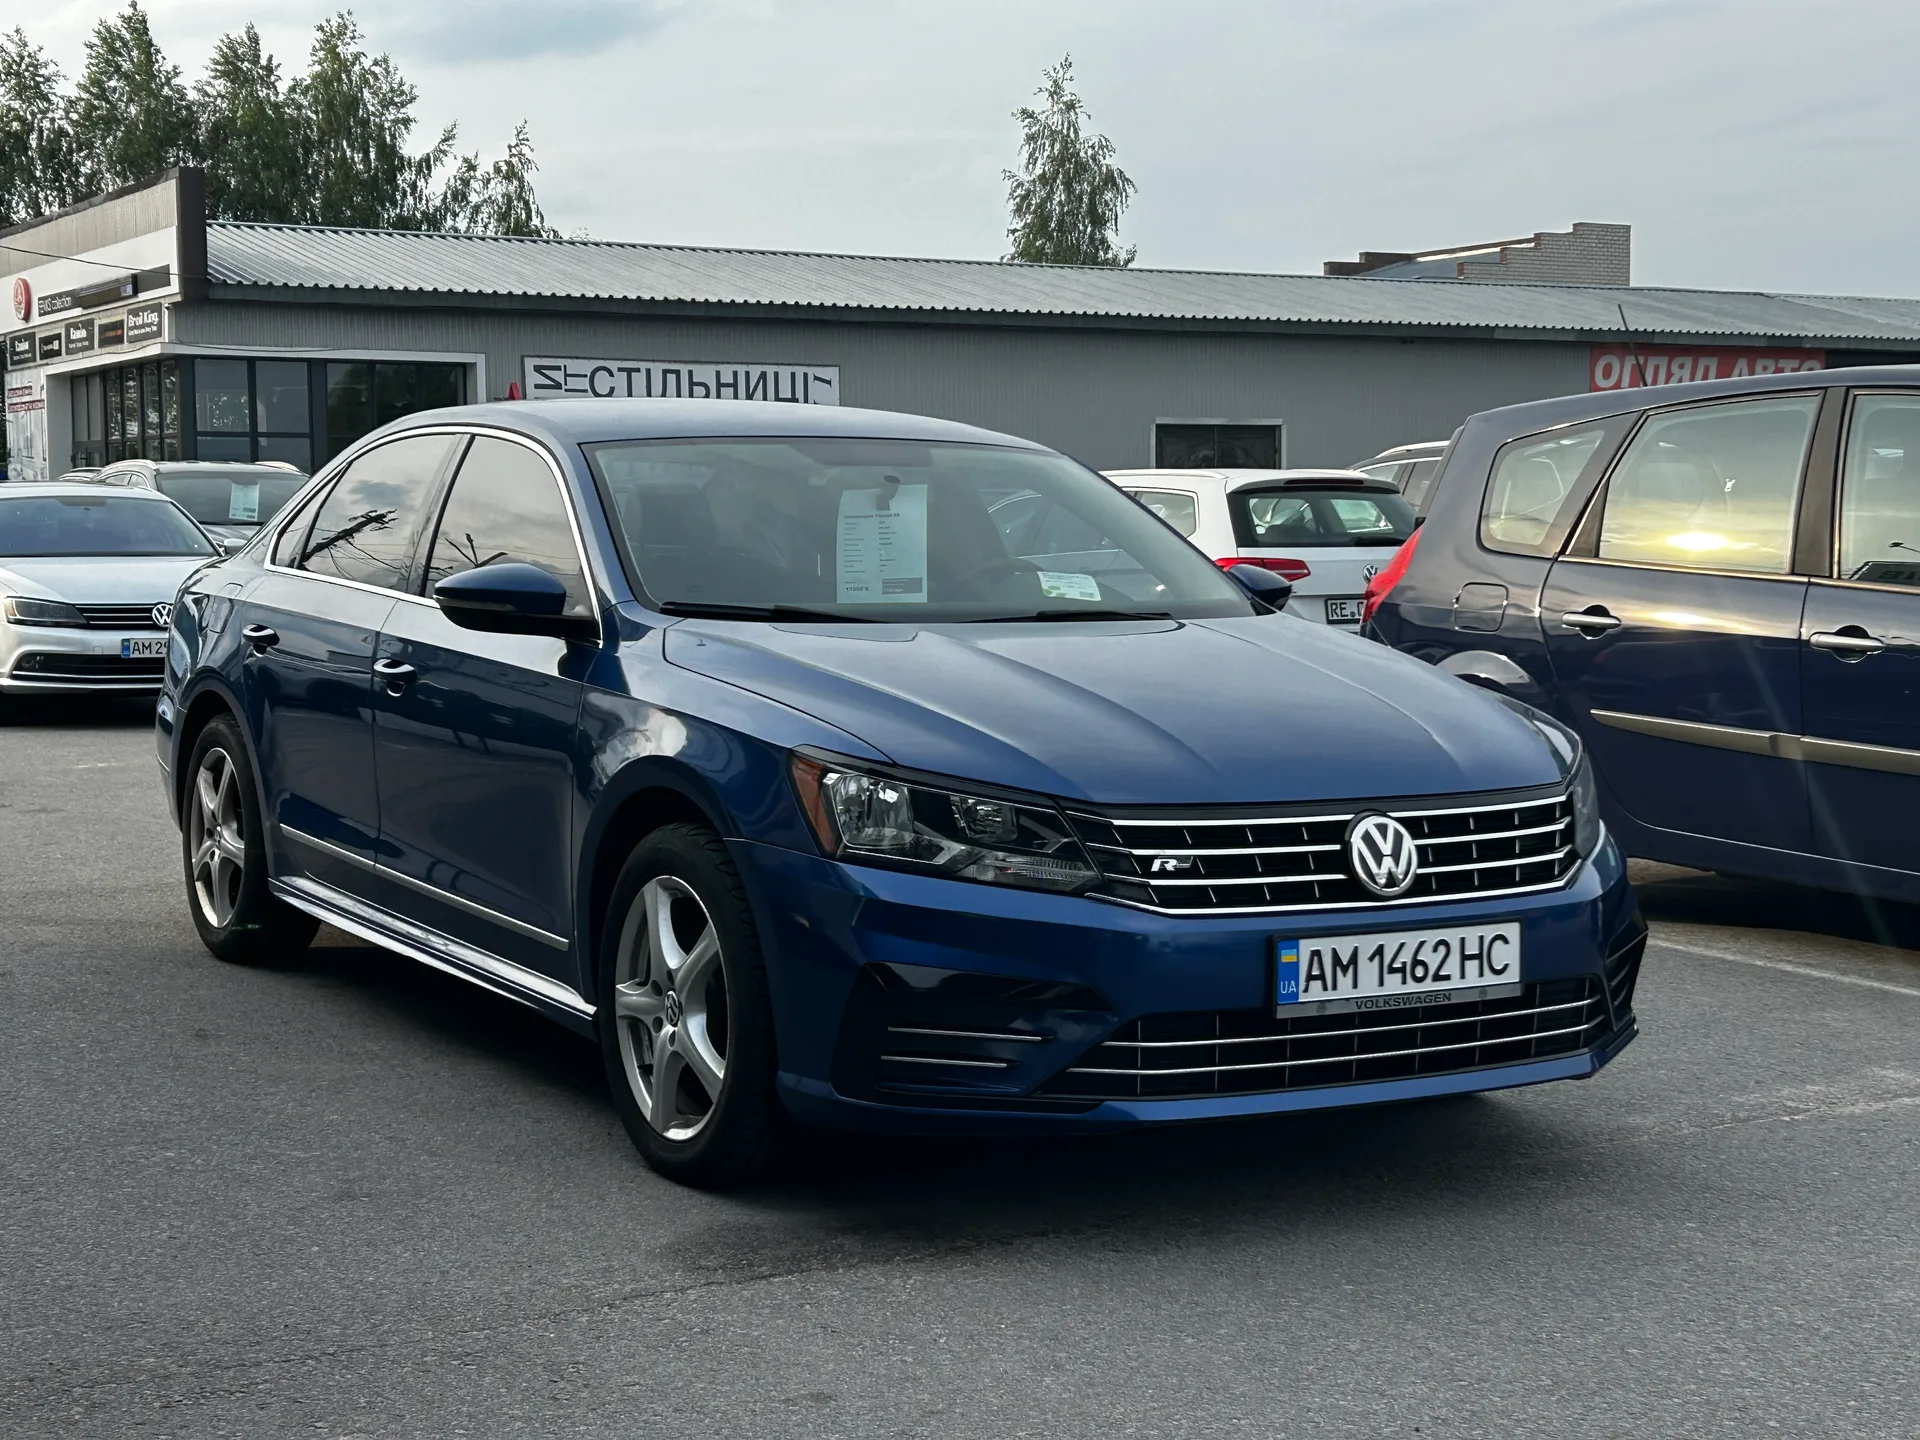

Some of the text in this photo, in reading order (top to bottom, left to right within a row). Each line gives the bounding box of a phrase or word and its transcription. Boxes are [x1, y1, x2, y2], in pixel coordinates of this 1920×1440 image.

[132, 641, 152, 655] AM
[1302, 933, 1510, 993] AM 1462 HC
[1280, 980, 1297, 994] UA
[1354, 992, 1452, 1010] VOLKSWAGEN
